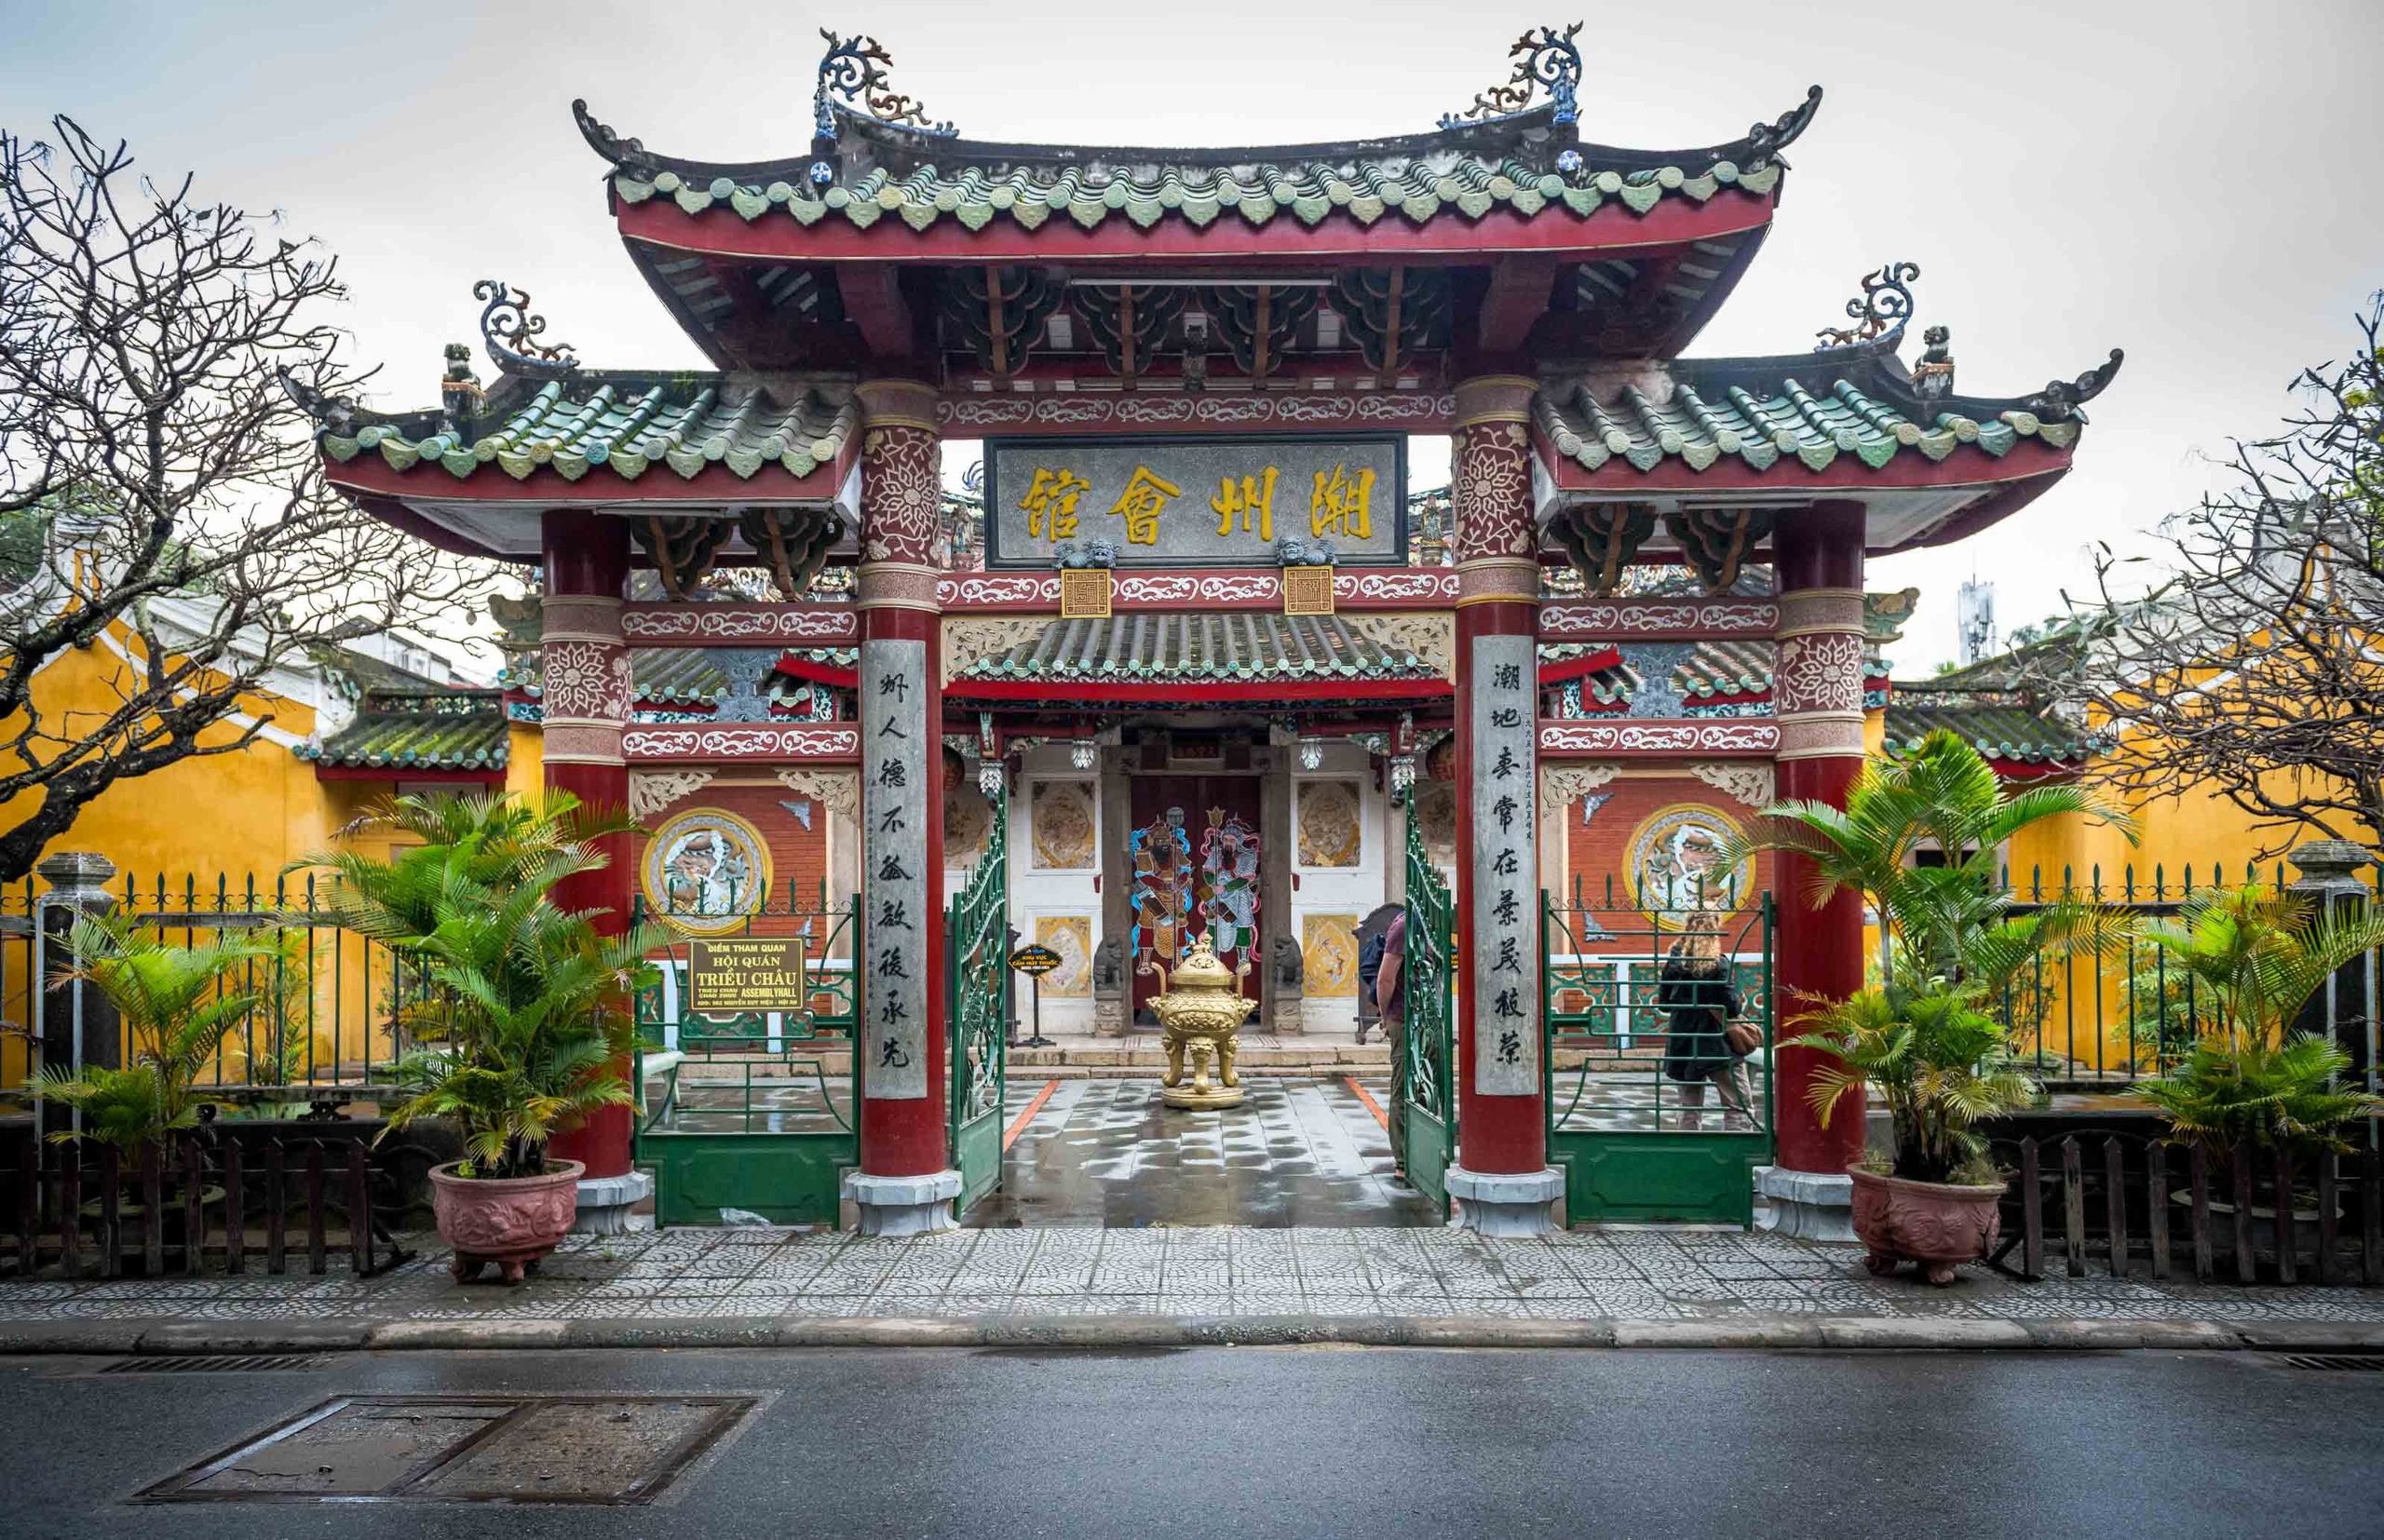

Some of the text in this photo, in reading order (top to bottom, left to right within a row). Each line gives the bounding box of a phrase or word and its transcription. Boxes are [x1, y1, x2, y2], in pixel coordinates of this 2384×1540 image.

[733, 944, 758, 952] THAM
[761, 944, 786, 952] QUAN
[713, 955, 780, 968] HỘI QUÁN
[751, 968, 797, 986] CHÂU
